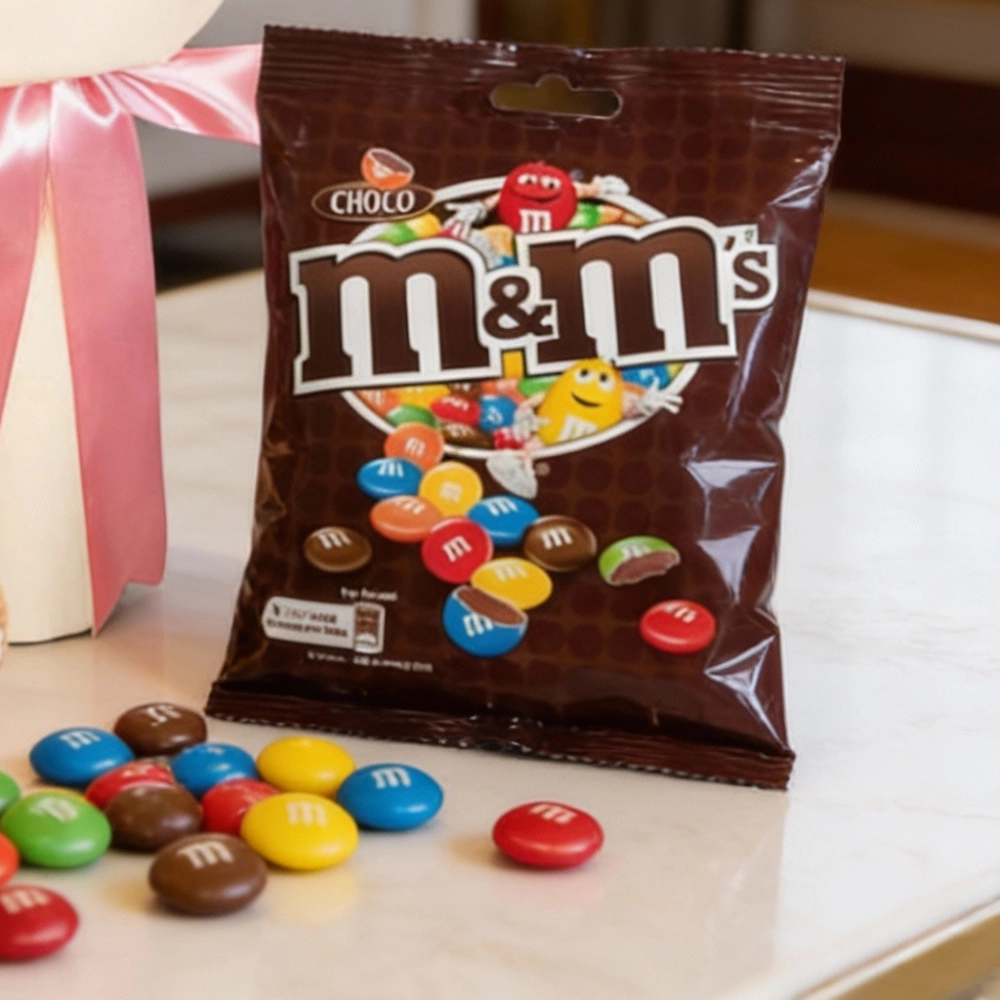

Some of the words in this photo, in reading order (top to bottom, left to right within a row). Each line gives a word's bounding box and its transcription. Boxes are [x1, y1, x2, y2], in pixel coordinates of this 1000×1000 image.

[329, 189, 416, 215] CHOCO
[519, 209, 552, 234] m
[317, 530, 352, 550] m
[442, 535, 473, 562] m
[538, 526, 573, 550] m
[371, 766, 412, 789] m
[286, 801, 328, 827] m
[176, 840, 235, 869] m
